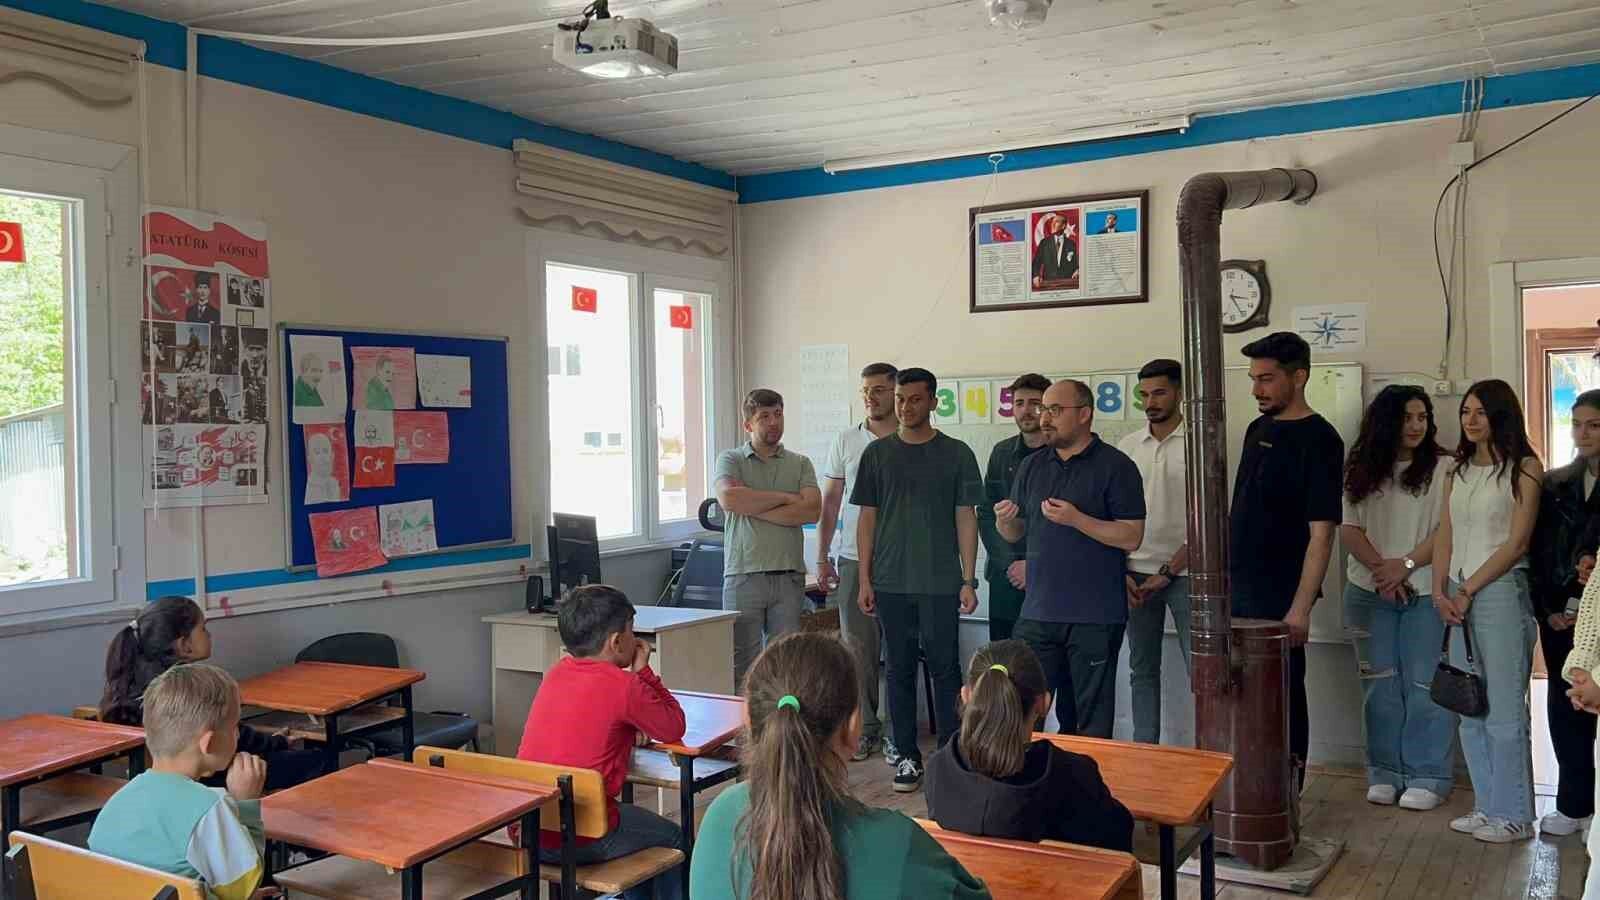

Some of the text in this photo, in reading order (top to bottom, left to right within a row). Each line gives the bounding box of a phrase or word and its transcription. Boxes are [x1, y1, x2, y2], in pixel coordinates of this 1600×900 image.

[936, 388, 957, 417] 3
[966, 387, 988, 417] 4
[998, 386, 1014, 417] 5
[1096, 381, 1122, 413] 8
